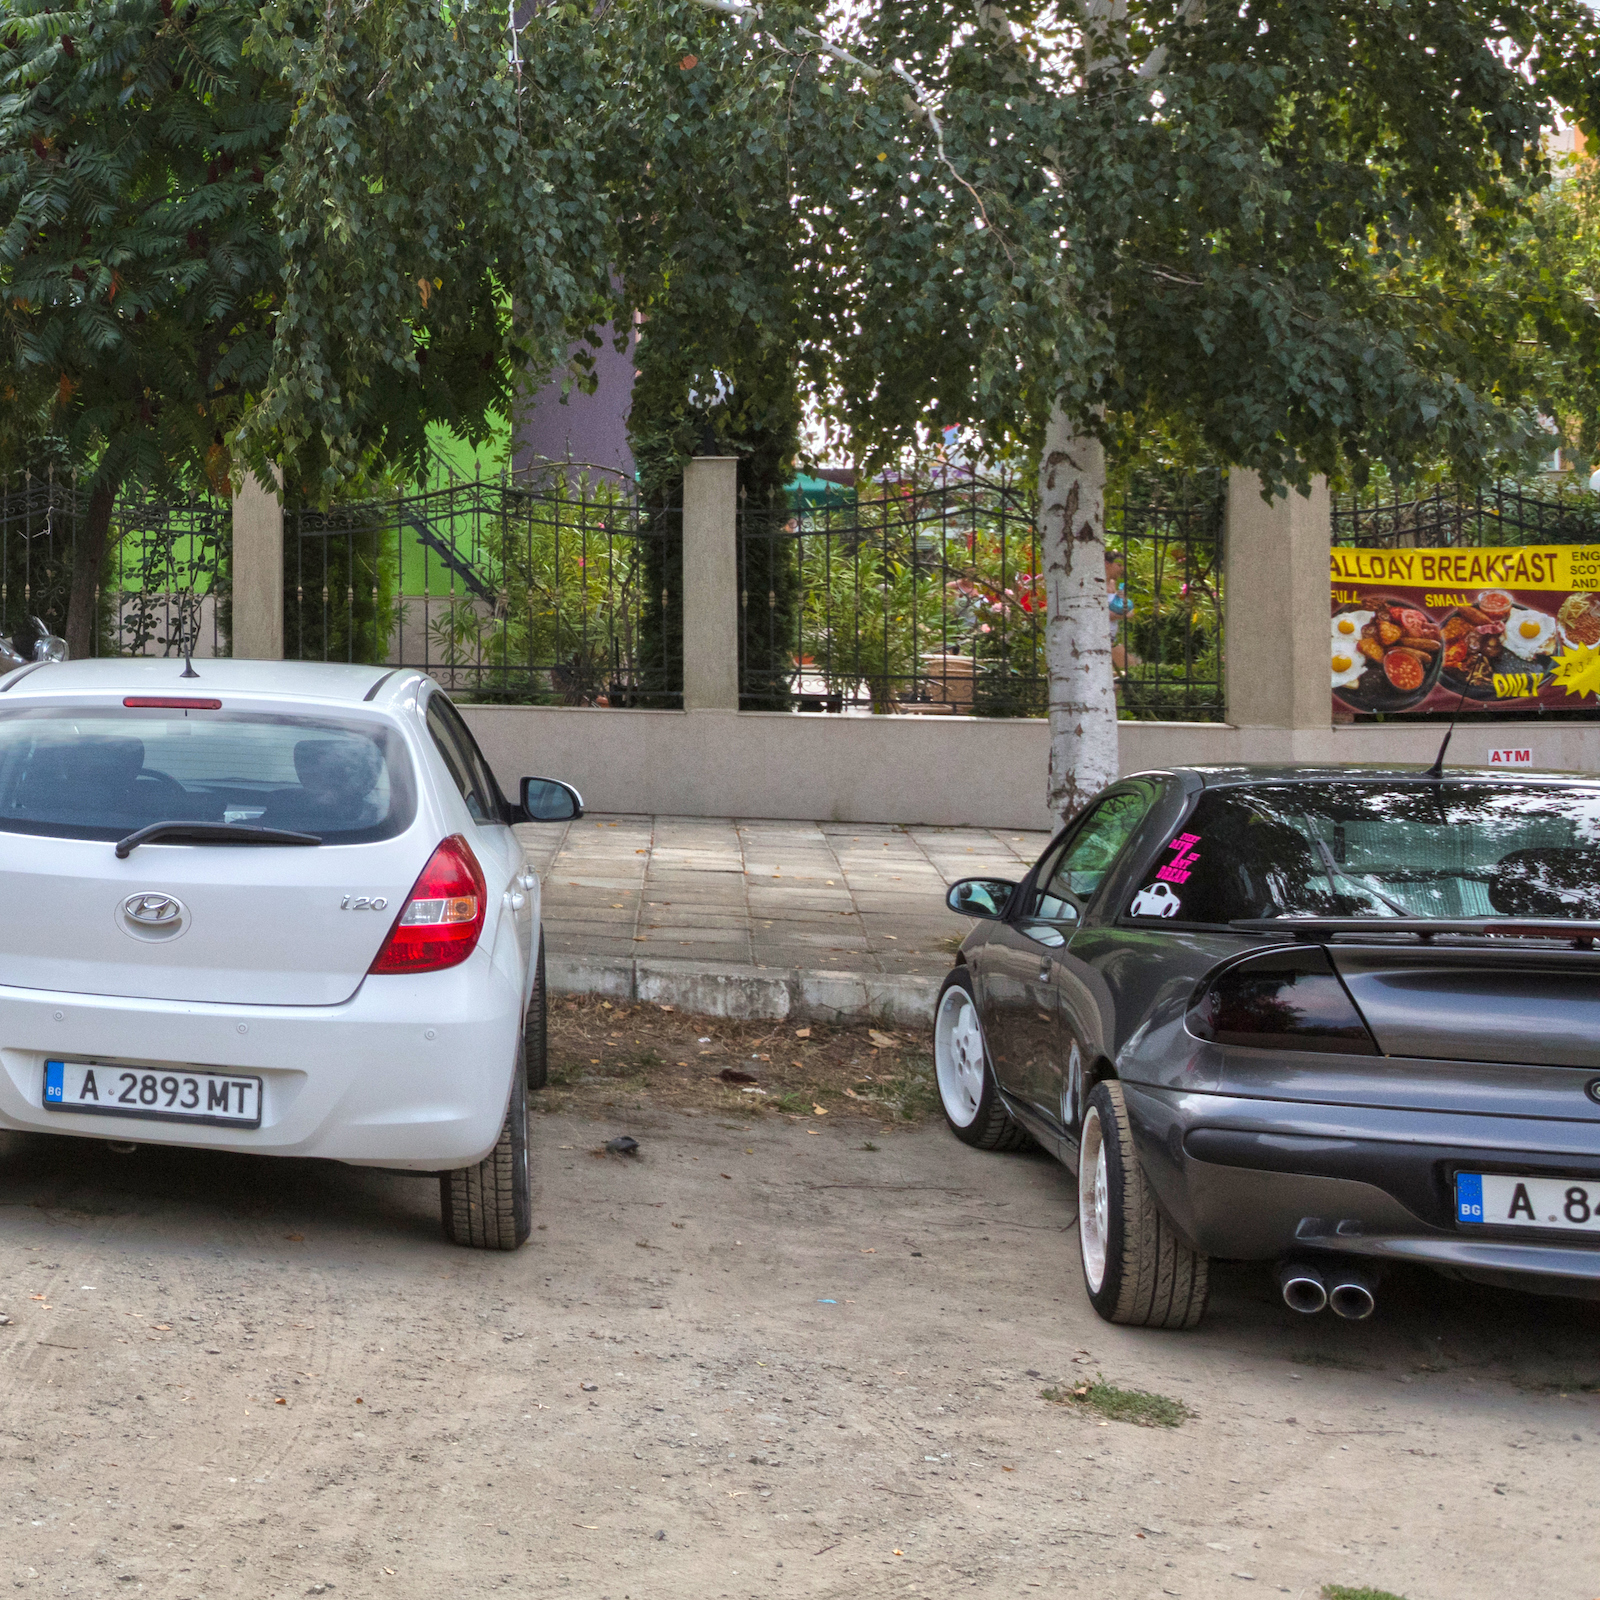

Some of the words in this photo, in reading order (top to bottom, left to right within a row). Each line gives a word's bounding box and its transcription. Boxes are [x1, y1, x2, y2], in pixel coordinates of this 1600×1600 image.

[1422, 553, 1557, 583] BREAKFAST
[1571, 578, 1599, 589] AND
[1424, 593, 1473, 608] SMALL
[1492, 672, 1544, 698] ONLY
[1491, 750, 1530, 763] ATM
[47, 1086, 62, 1097] BG
[1461, 1203, 1481, 1216] BG
[1564, 1186, 1600, 1224] 8
